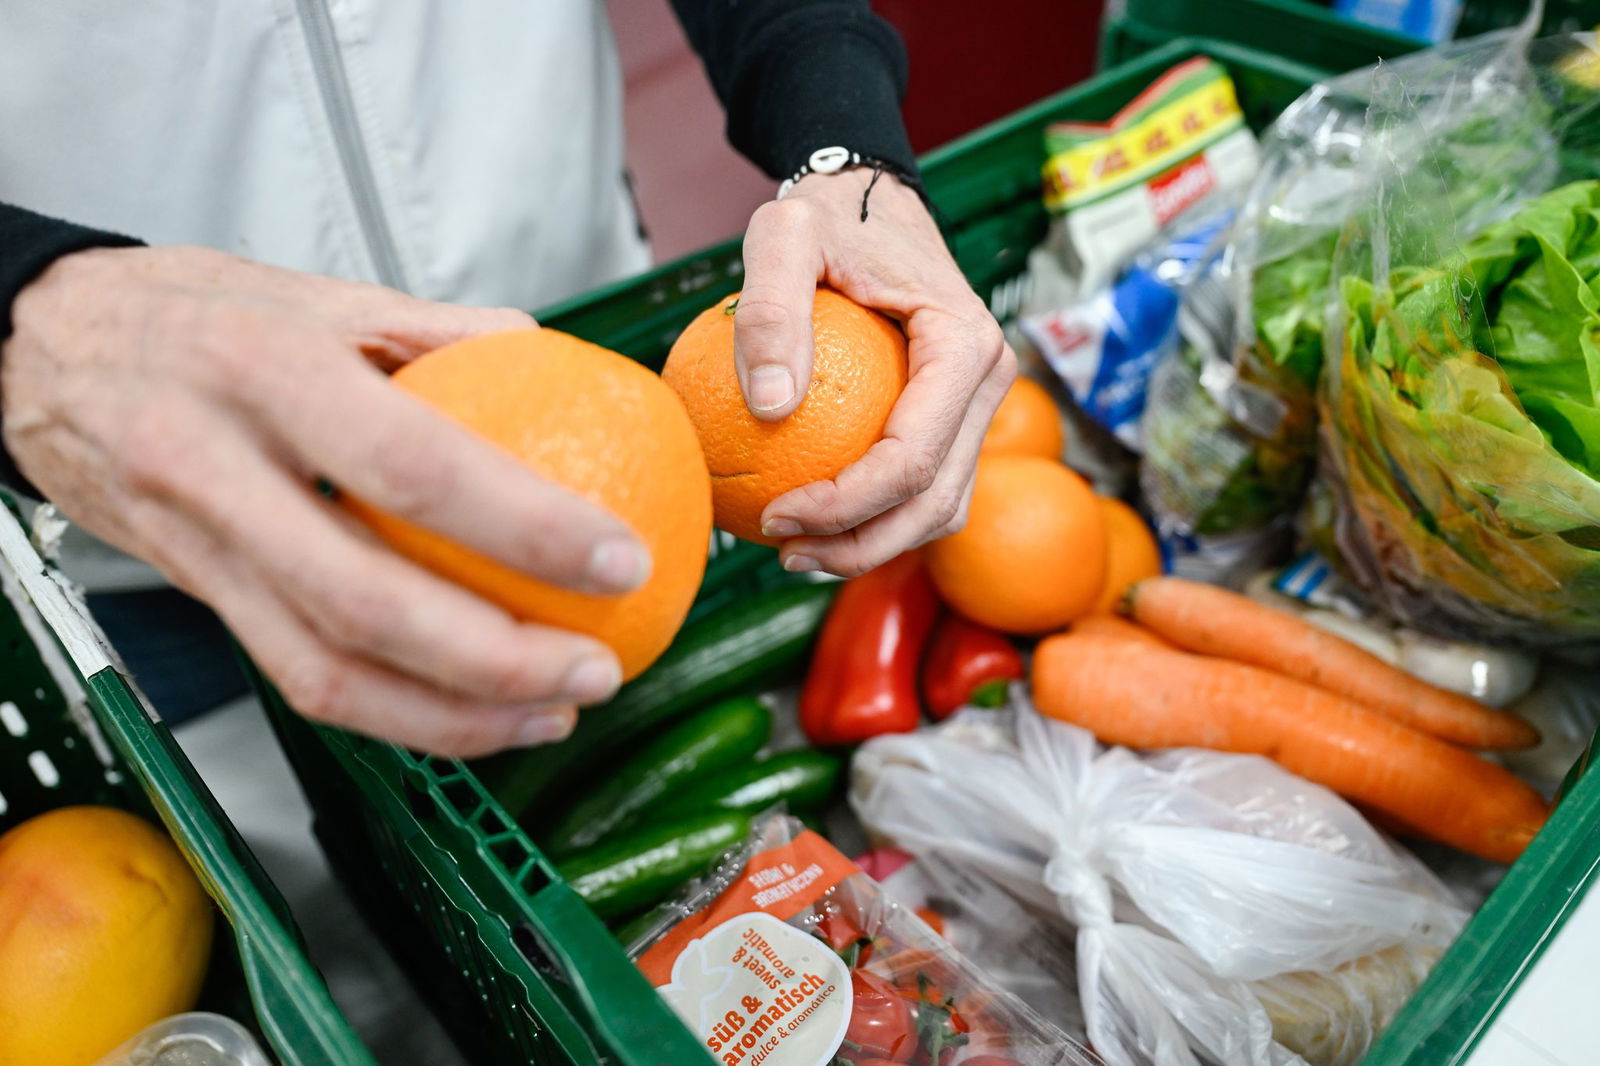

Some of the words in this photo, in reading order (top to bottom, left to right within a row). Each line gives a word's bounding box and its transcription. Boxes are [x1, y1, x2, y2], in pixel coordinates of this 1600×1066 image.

[731, 946, 748, 963] &
[742, 928, 796, 979] aromatic
[742, 955, 781, 990] sweet
[706, 1010, 746, 1053] süß
[741, 995, 763, 1014] &
[722, 972, 826, 1066] aromatisch
[751, 1035, 780, 1066] dulce
[776, 1026, 791, 1039] &
[787, 984, 837, 1032] aromático
